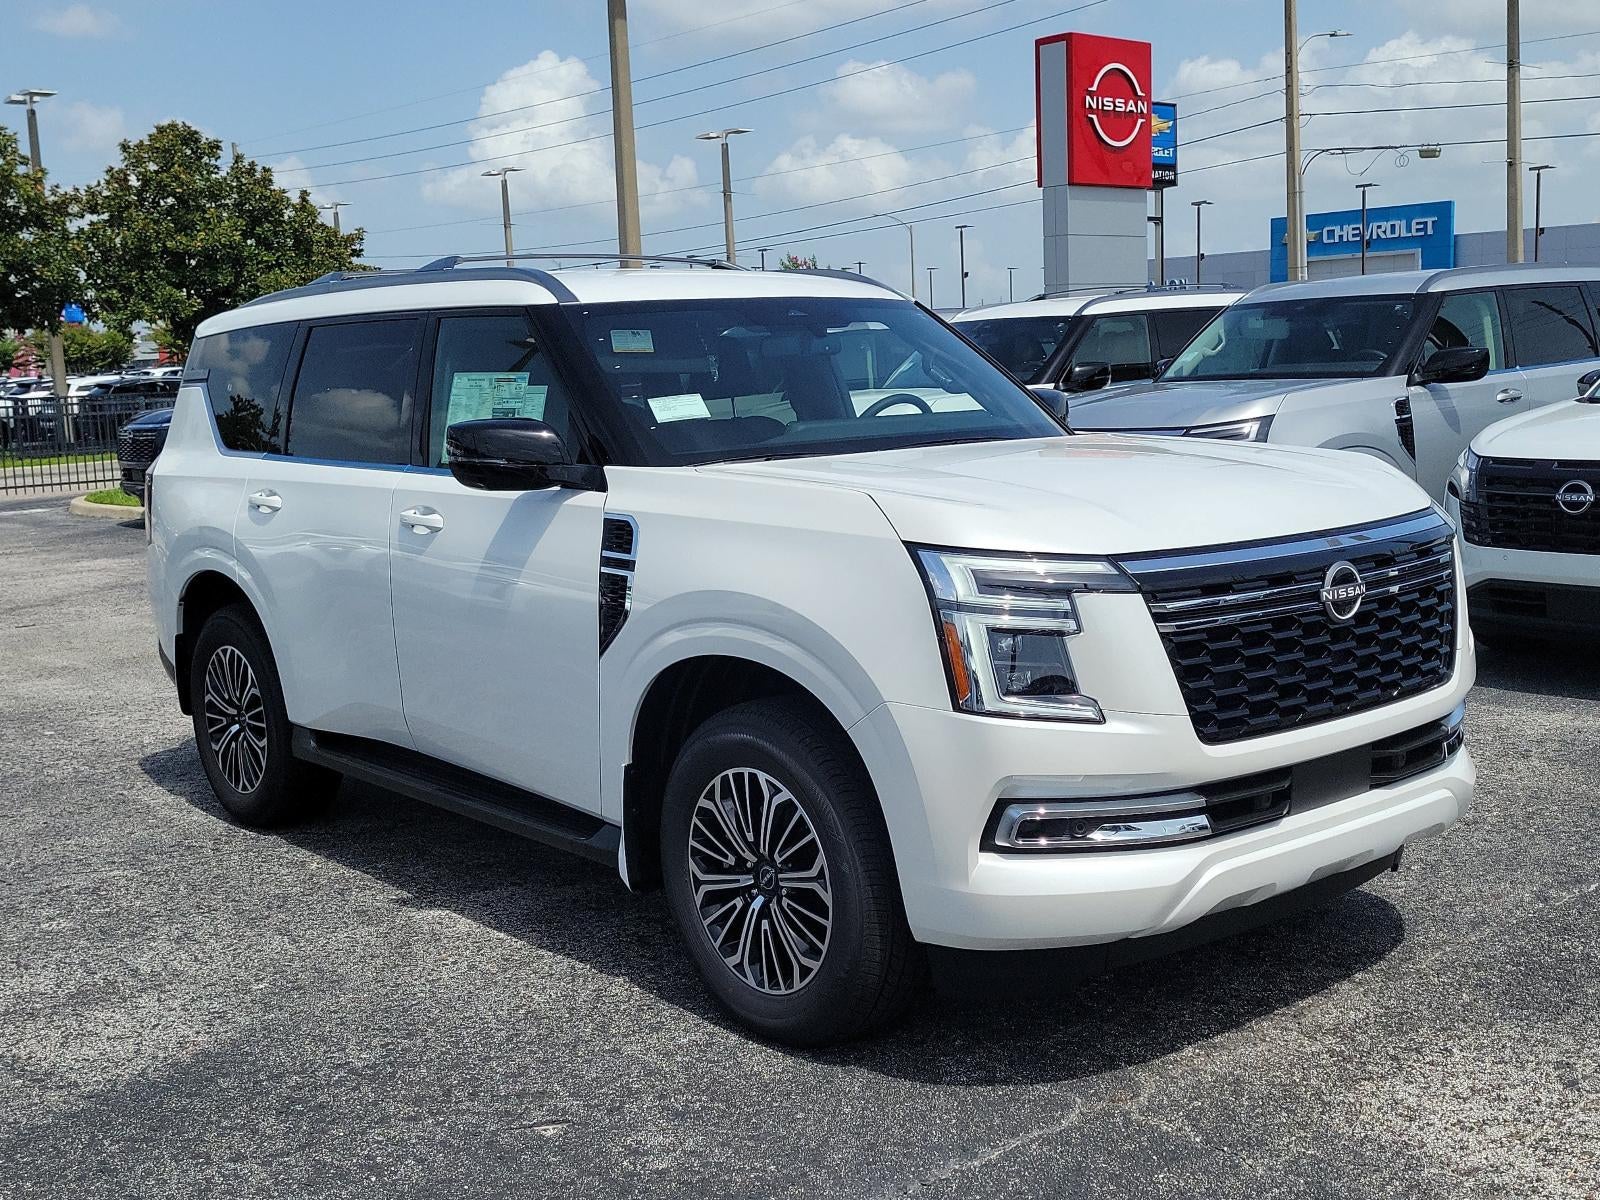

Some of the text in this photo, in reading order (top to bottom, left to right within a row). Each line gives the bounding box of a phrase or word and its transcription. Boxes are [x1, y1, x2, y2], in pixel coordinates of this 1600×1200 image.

[1085, 95, 1147, 114] NISSAN
[1322, 216, 1438, 243] CHEVROLET
[1555, 494, 1594, 502] NISSAN
[1322, 583, 1366, 601] NISSAN
